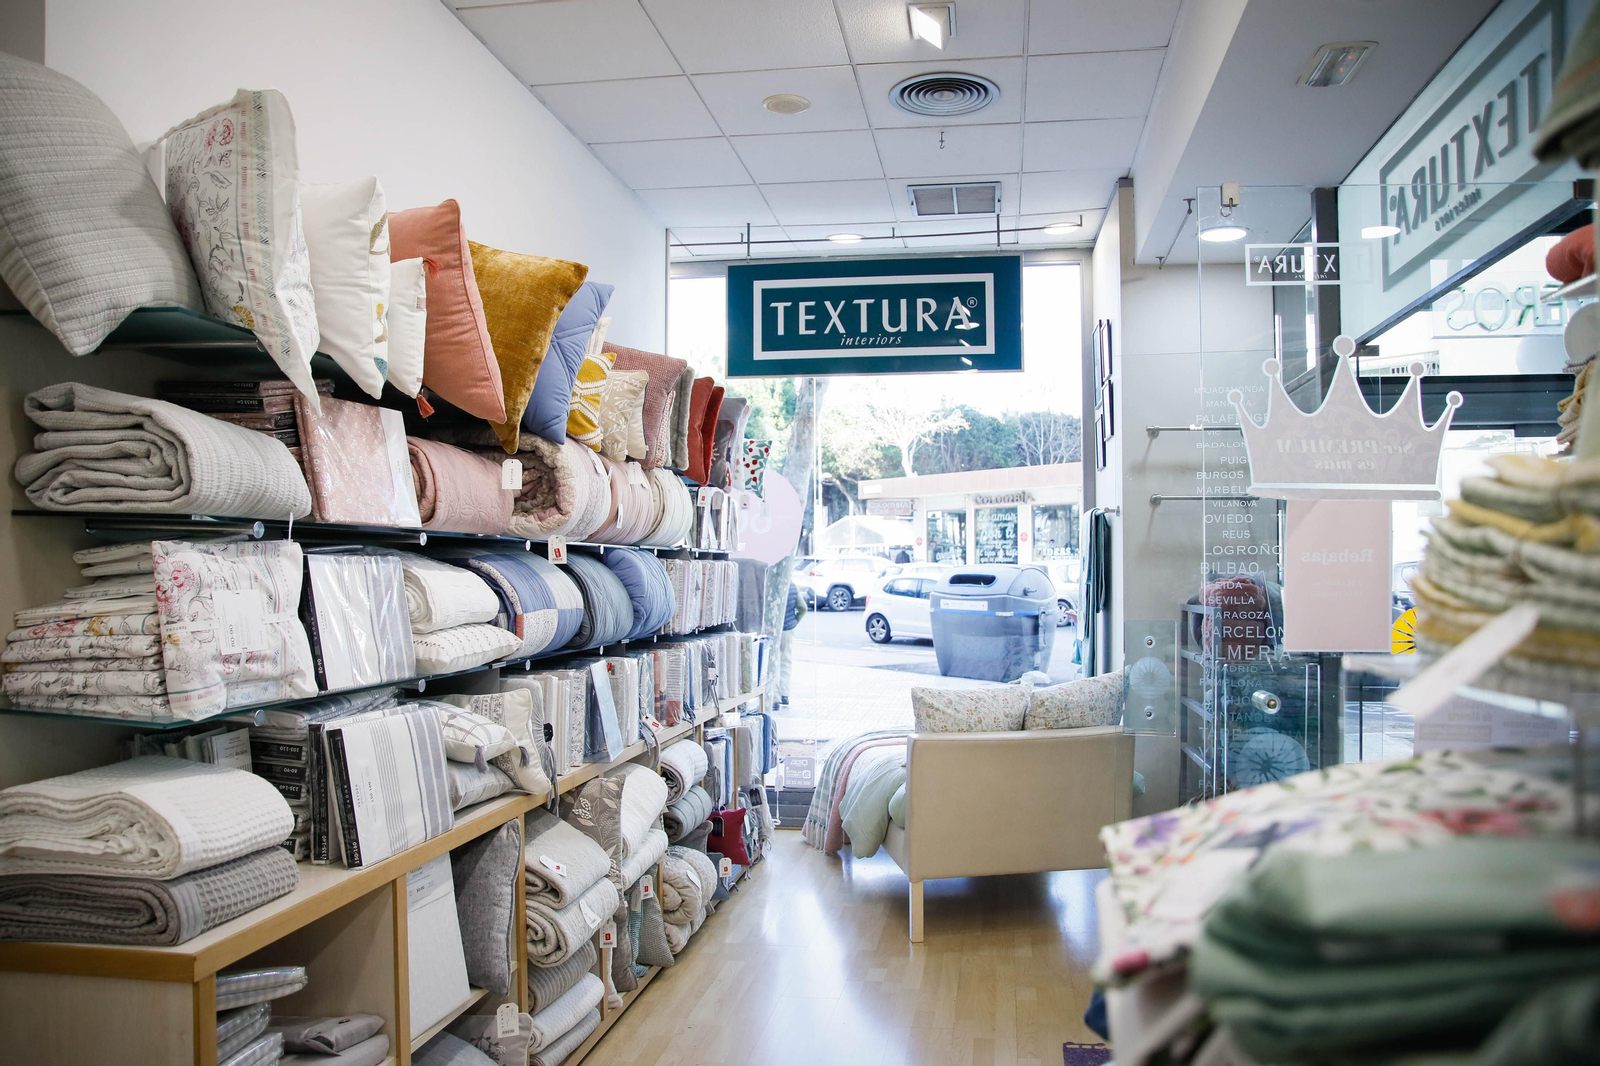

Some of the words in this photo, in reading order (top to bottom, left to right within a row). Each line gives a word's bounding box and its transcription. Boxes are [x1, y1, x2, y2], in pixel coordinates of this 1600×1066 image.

[840, 333, 902, 346] interiors
[1196, 471, 1244, 480] BURGOS
[1204, 513, 1253, 524] OVIEDO
[1222, 530, 1250, 539] REUS
[1201, 562, 1259, 575] BILBAO
[1208, 596, 1255, 604] SEVILLA
